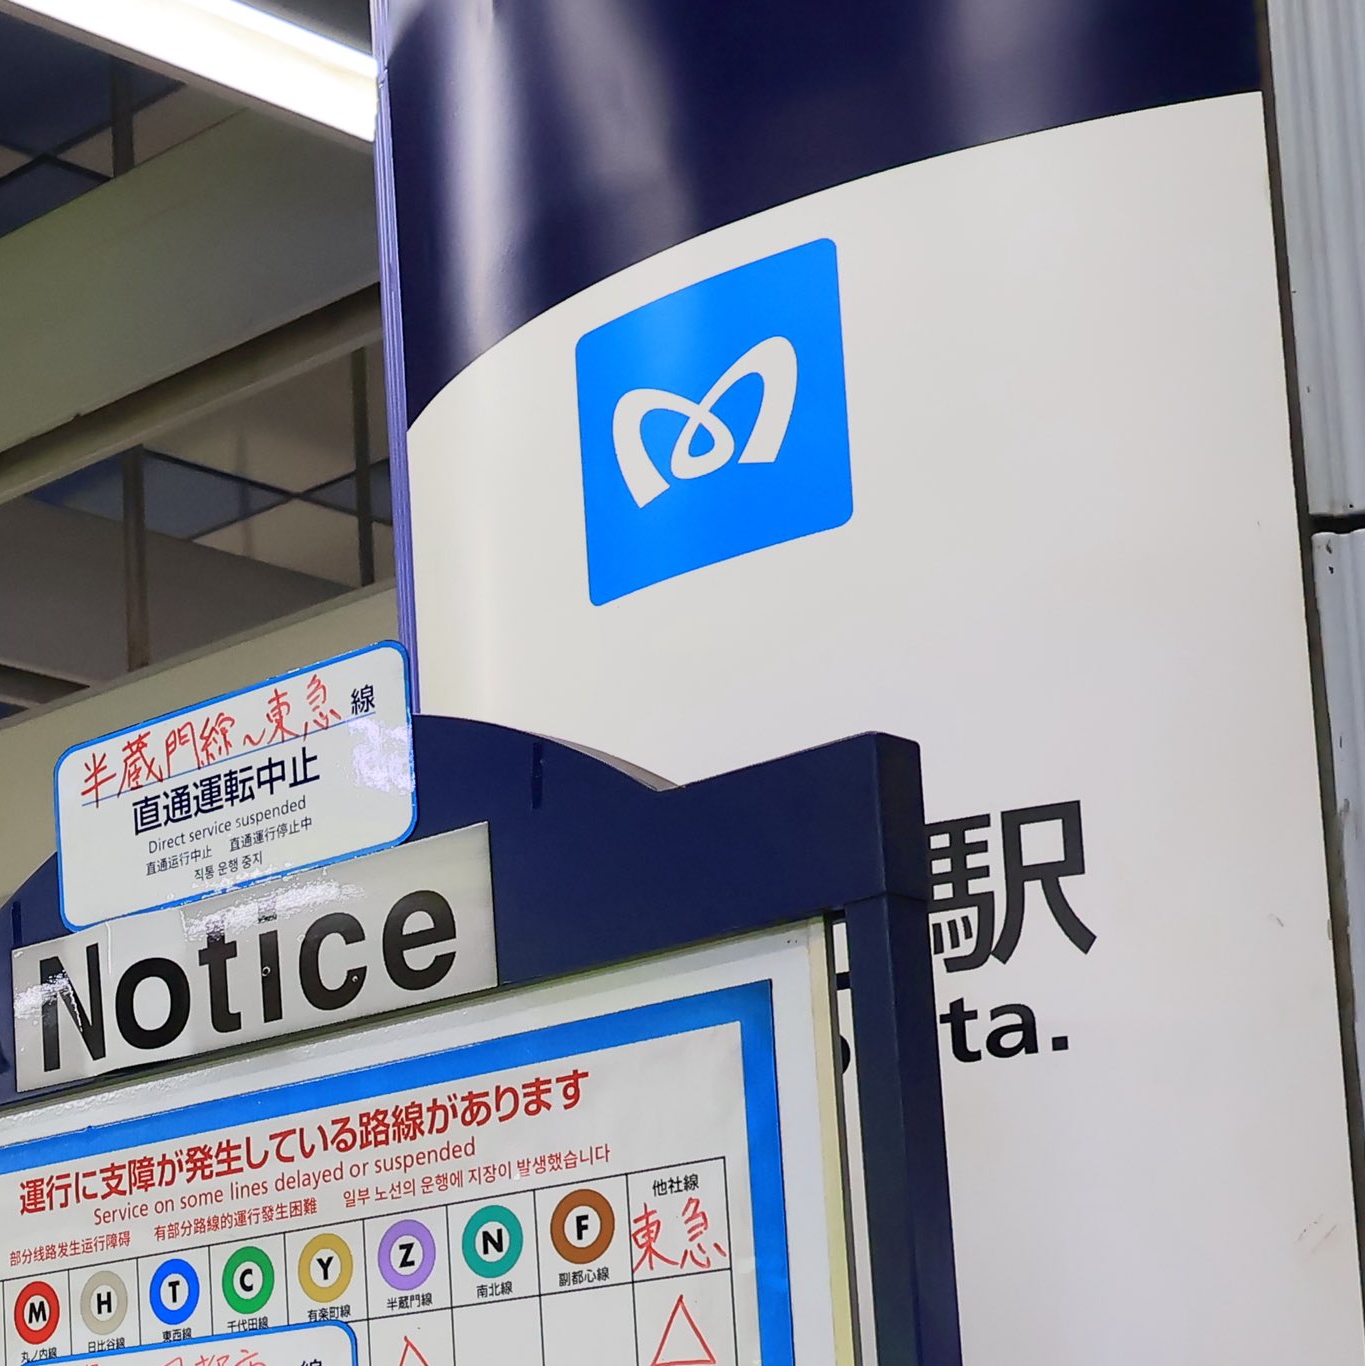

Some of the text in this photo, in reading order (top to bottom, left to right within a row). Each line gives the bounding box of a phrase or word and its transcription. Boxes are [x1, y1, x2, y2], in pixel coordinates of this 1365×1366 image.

[350, 684, 376, 716] 線
[132, 746, 321, 836] 直通運転中止
[148, 796, 306, 854] Direct service suspended
[146, 816, 312, 876] 直通运行中止 直通運行停止中
[194, 851, 263, 881] 직통 운행 중지
[39, 888, 457, 1072] Notice
[940, 997, 1069, 1063] ta.
[19, 1069, 590, 1215] 運行に支障が発生している路線があります
[94, 1137, 476, 1226] Service on some lines delayed or suspended
[343, 1143, 611, 1208] 일부 노선의 운행에 지장이 발생했습니다
[652, 1173, 700, 1197] 他社線
[9, 1197, 318, 1268] 部分线路发生运行障碍 有部分路線的運行發生困難
[575, 1214, 589, 1240] F
[630, 1197, 727, 1273] 東急
[481, 1228, 503, 1255] N
[398, 1242, 416, 1268] Z
[239, 1268, 254, 1292] C
[316, 1256, 334, 1281] Y
[558, 1267, 610, 1287] 副都心線
[168, 1281, 180, 1303] T
[386, 1293, 433, 1310] 半蔵門線
[476, 1281, 513, 1298] 南北線
[28, 1300, 47, 1324] M
[96, 1291, 112, 1315] H
[307, 1304, 351, 1322] 有楽町線
[162, 1327, 192, 1343] 東西線
[227, 1316, 269, 1332] 千代田線
[87, 1337, 126, 1354] 日比谷線
